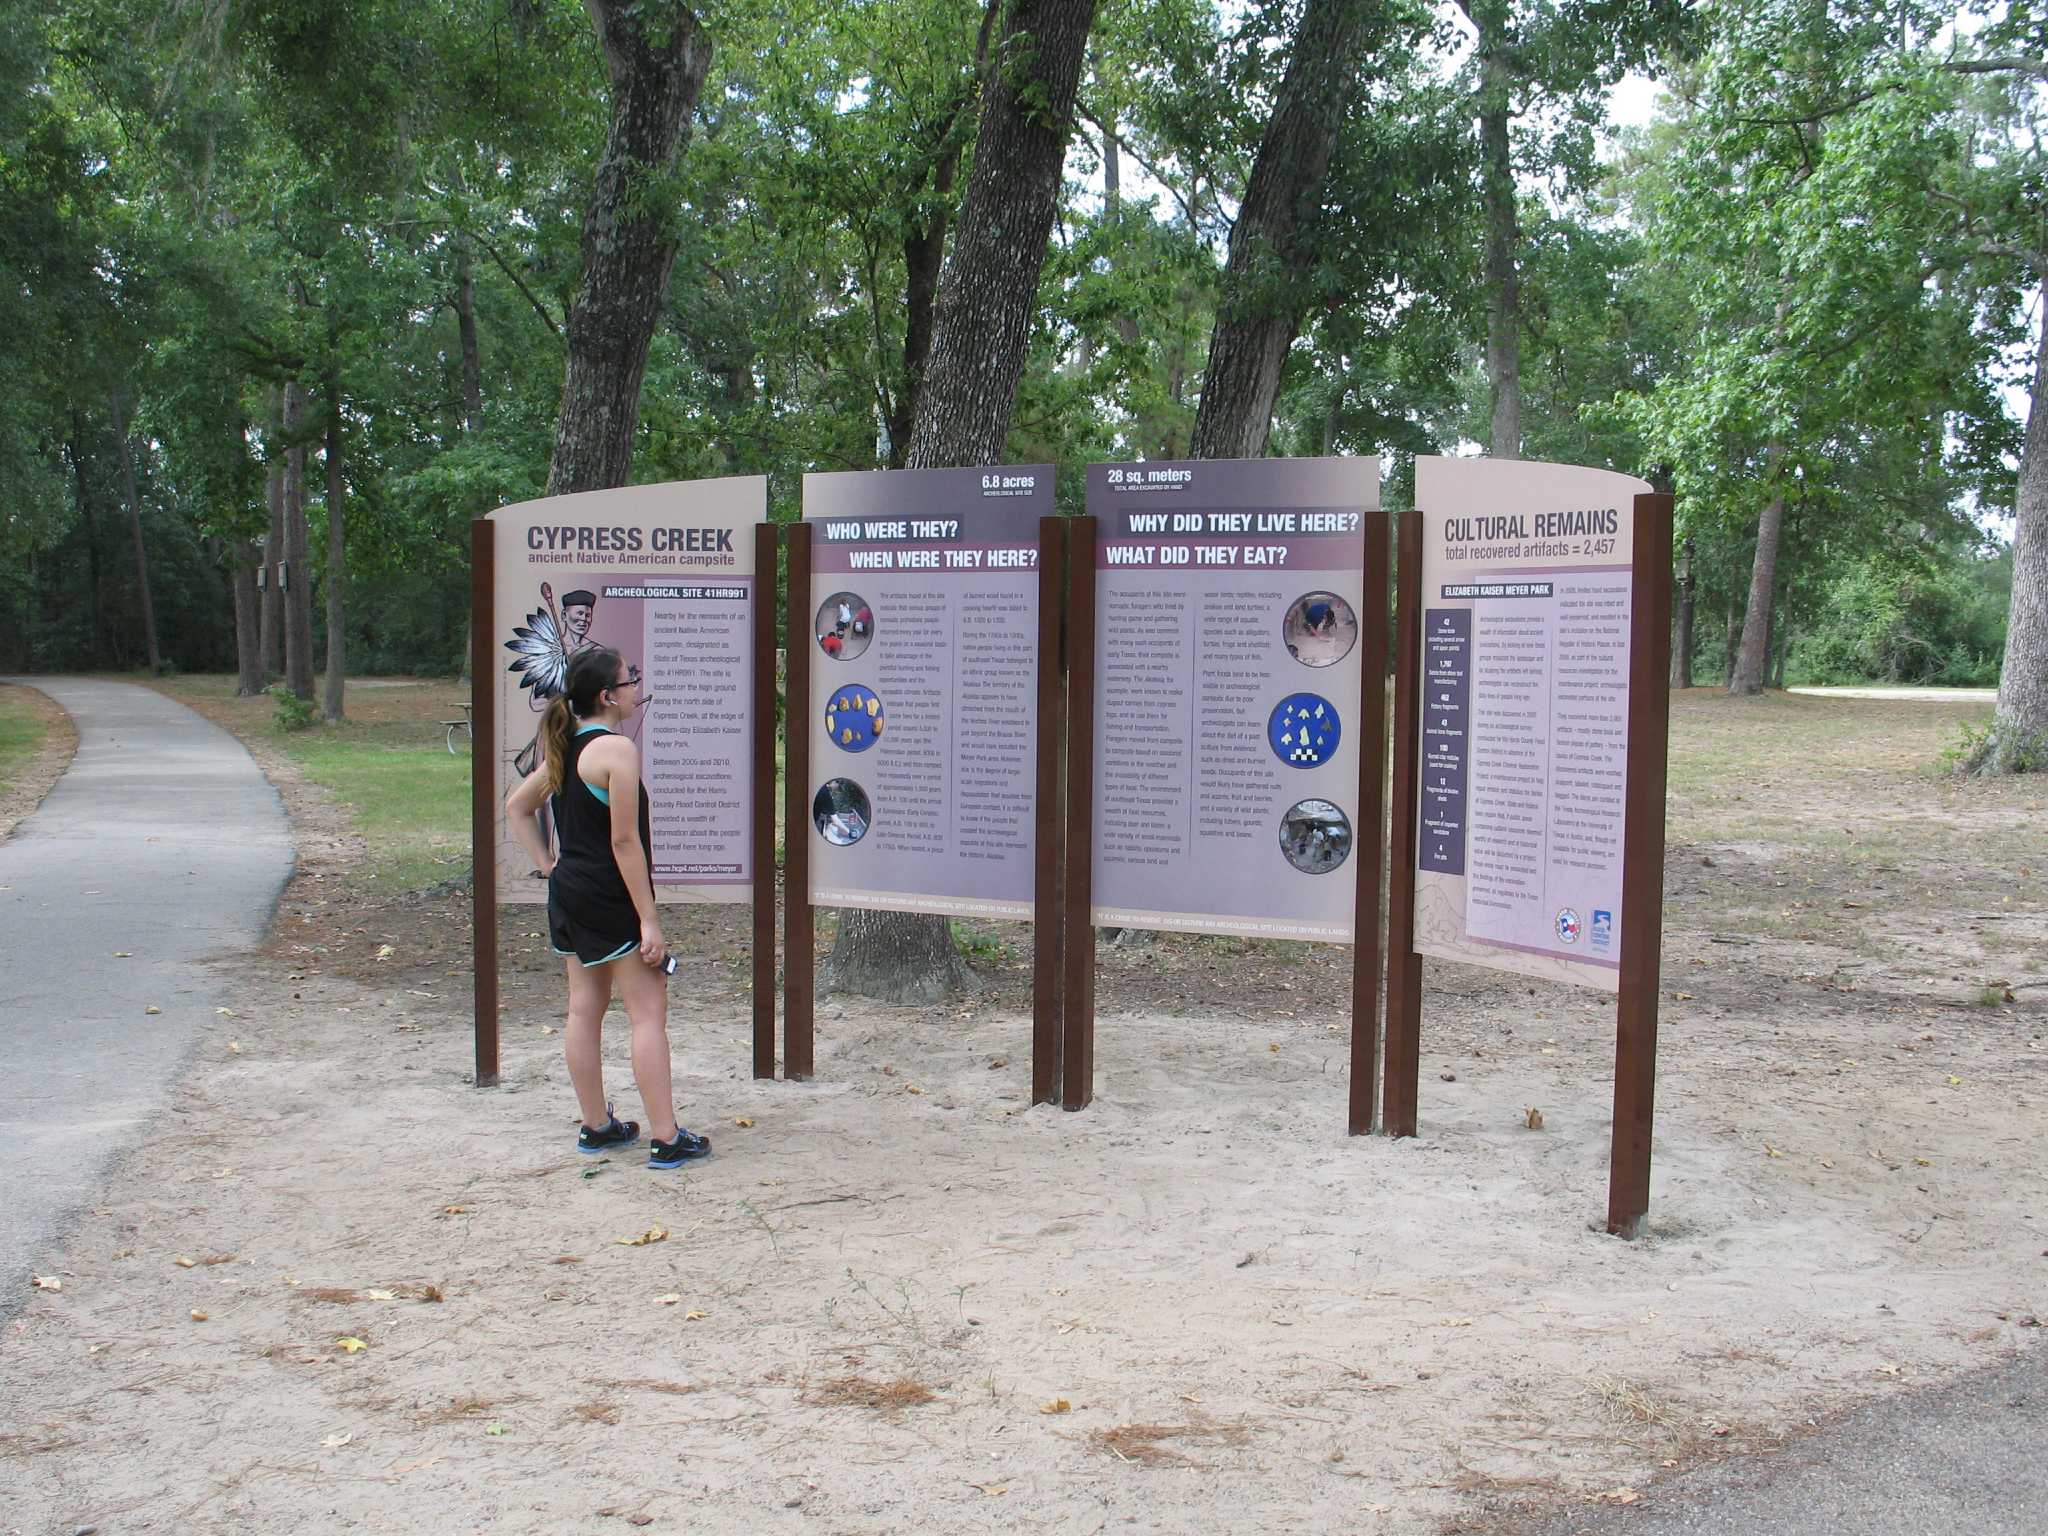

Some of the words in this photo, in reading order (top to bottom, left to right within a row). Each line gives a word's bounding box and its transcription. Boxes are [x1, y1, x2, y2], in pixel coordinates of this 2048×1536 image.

[983, 475, 1000, 488] 6.8
[1003, 476, 1034, 488] acres
[1108, 469, 1123, 482] 28
[1126, 471, 1144, 484] sq.
[1148, 468, 1192, 482] meters
[827, 522, 861, 539] WHO
[864, 521, 906, 539] WERE
[911, 520, 958, 538] THEY?
[1129, 514, 1168, 532] WHY
[1174, 514, 1202, 532] DID
[1208, 514, 1252, 532] THEY
[1257, 514, 1295, 532] LIVE
[1301, 513, 1359, 532] HERE?
[1444, 515, 1529, 542] CULTURAL
[1534, 509, 1618, 538] REMAINS
[528, 526, 642, 551] CYPRESS
[651, 527, 734, 552] CREEK
[850, 551, 892, 568] WHEN
[897, 551, 940, 568] WERE
[944, 550, 982, 567] THEY
[987, 549, 1037, 567] HERE?
[1106, 546, 1155, 564] WHAT
[1161, 546, 1190, 564] DID
[1195, 546, 1239, 564] THEY
[1244, 546, 1288, 564] EAT?
[1445, 546, 1467, 560] total
[1470, 542, 1521, 559] recovered
[1524, 540, 1569, 558] artifacts
[1572, 546, 1581, 554] =
[1584, 539, 1615, 557] 2,457
[528, 552, 572, 563] ancient
[577, 552, 615, 564] Native
[619, 552, 675, 565] American
[679, 553, 735, 567] campsite
[605, 587, 680, 597] ARCHEOLOGICAL
[683, 588, 702, 598] SITE
[705, 588, 744, 598] 41HR991
[1445, 586, 1479, 596] ELIZABETH
[1481, 585, 1504, 595] KAISER
[1506, 585, 1529, 595] MEYER
[1531, 584, 1549, 594] PARK
